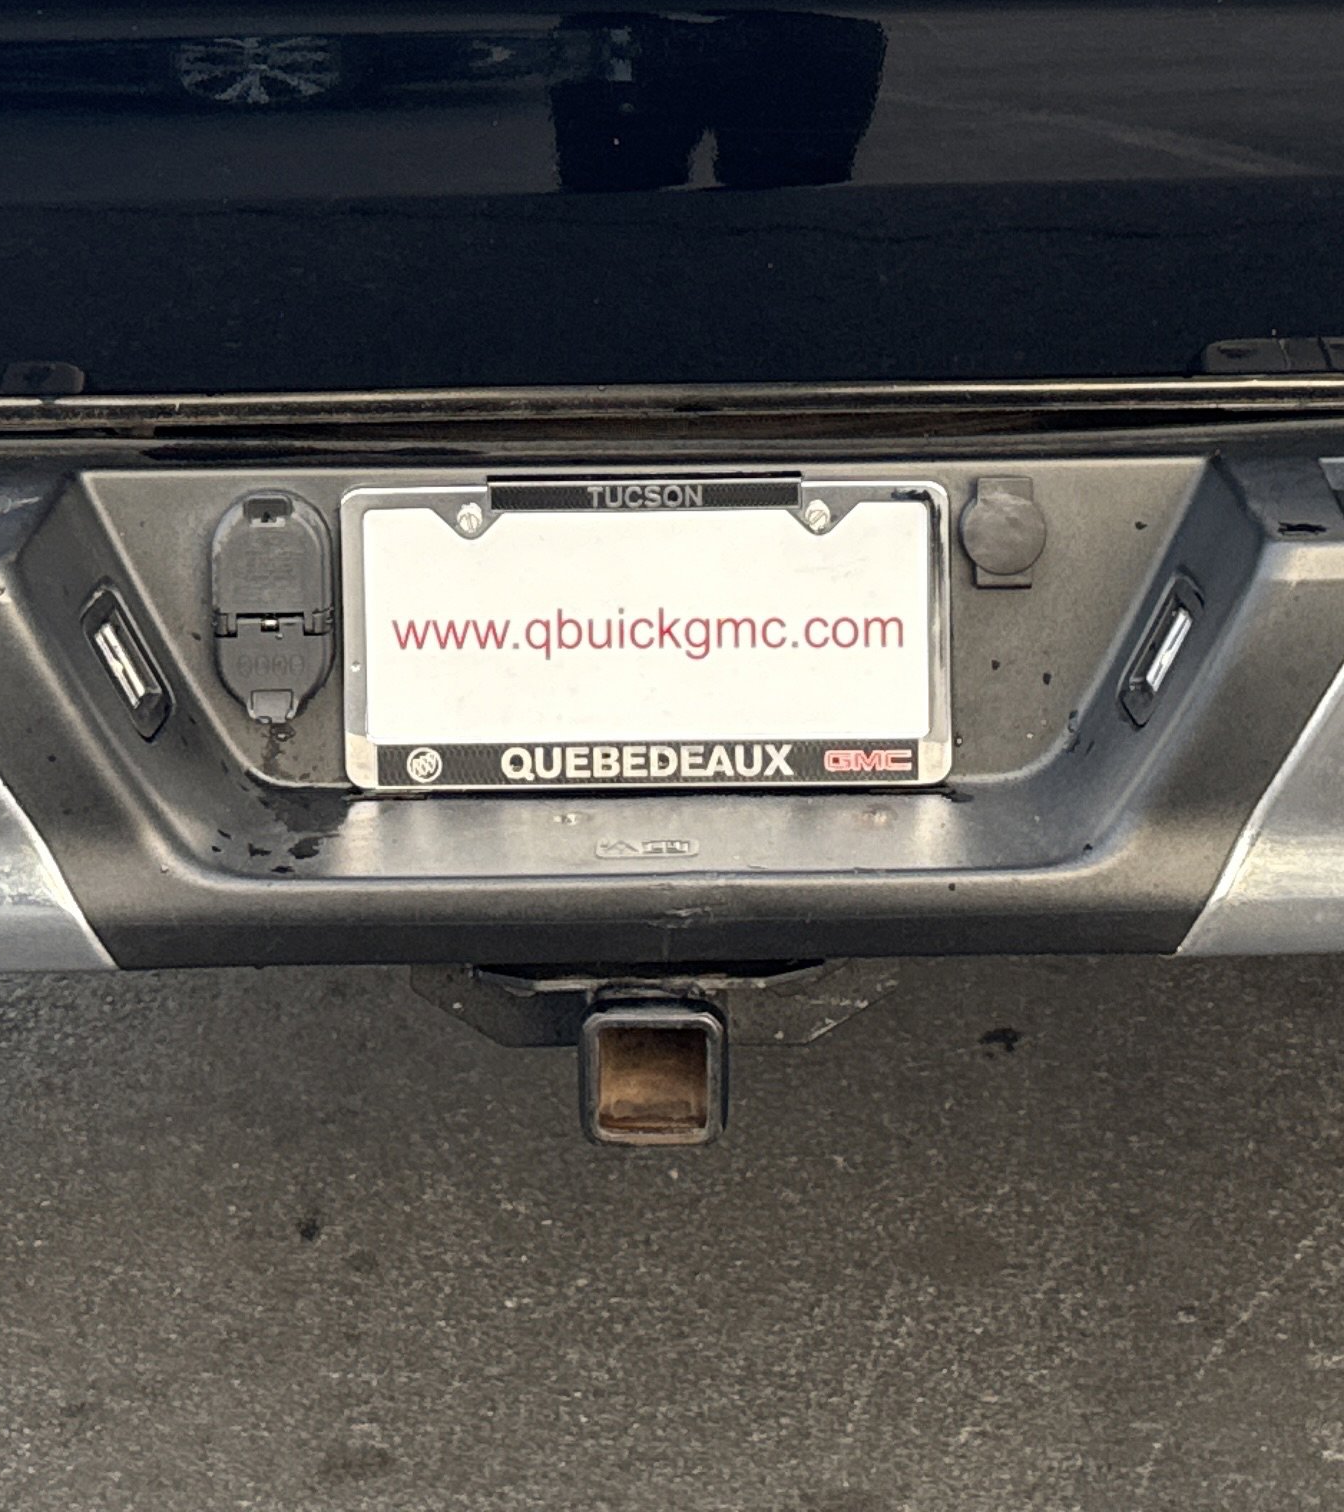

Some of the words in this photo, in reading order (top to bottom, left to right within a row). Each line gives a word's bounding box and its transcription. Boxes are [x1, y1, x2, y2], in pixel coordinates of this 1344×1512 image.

[586, 484, 704, 509] TUCSON
[392, 607, 904, 660] www.qbuickgmc.com
[500, 744, 794, 780] QUEBEDEAUX
[823, 749, 913, 772] GMC
